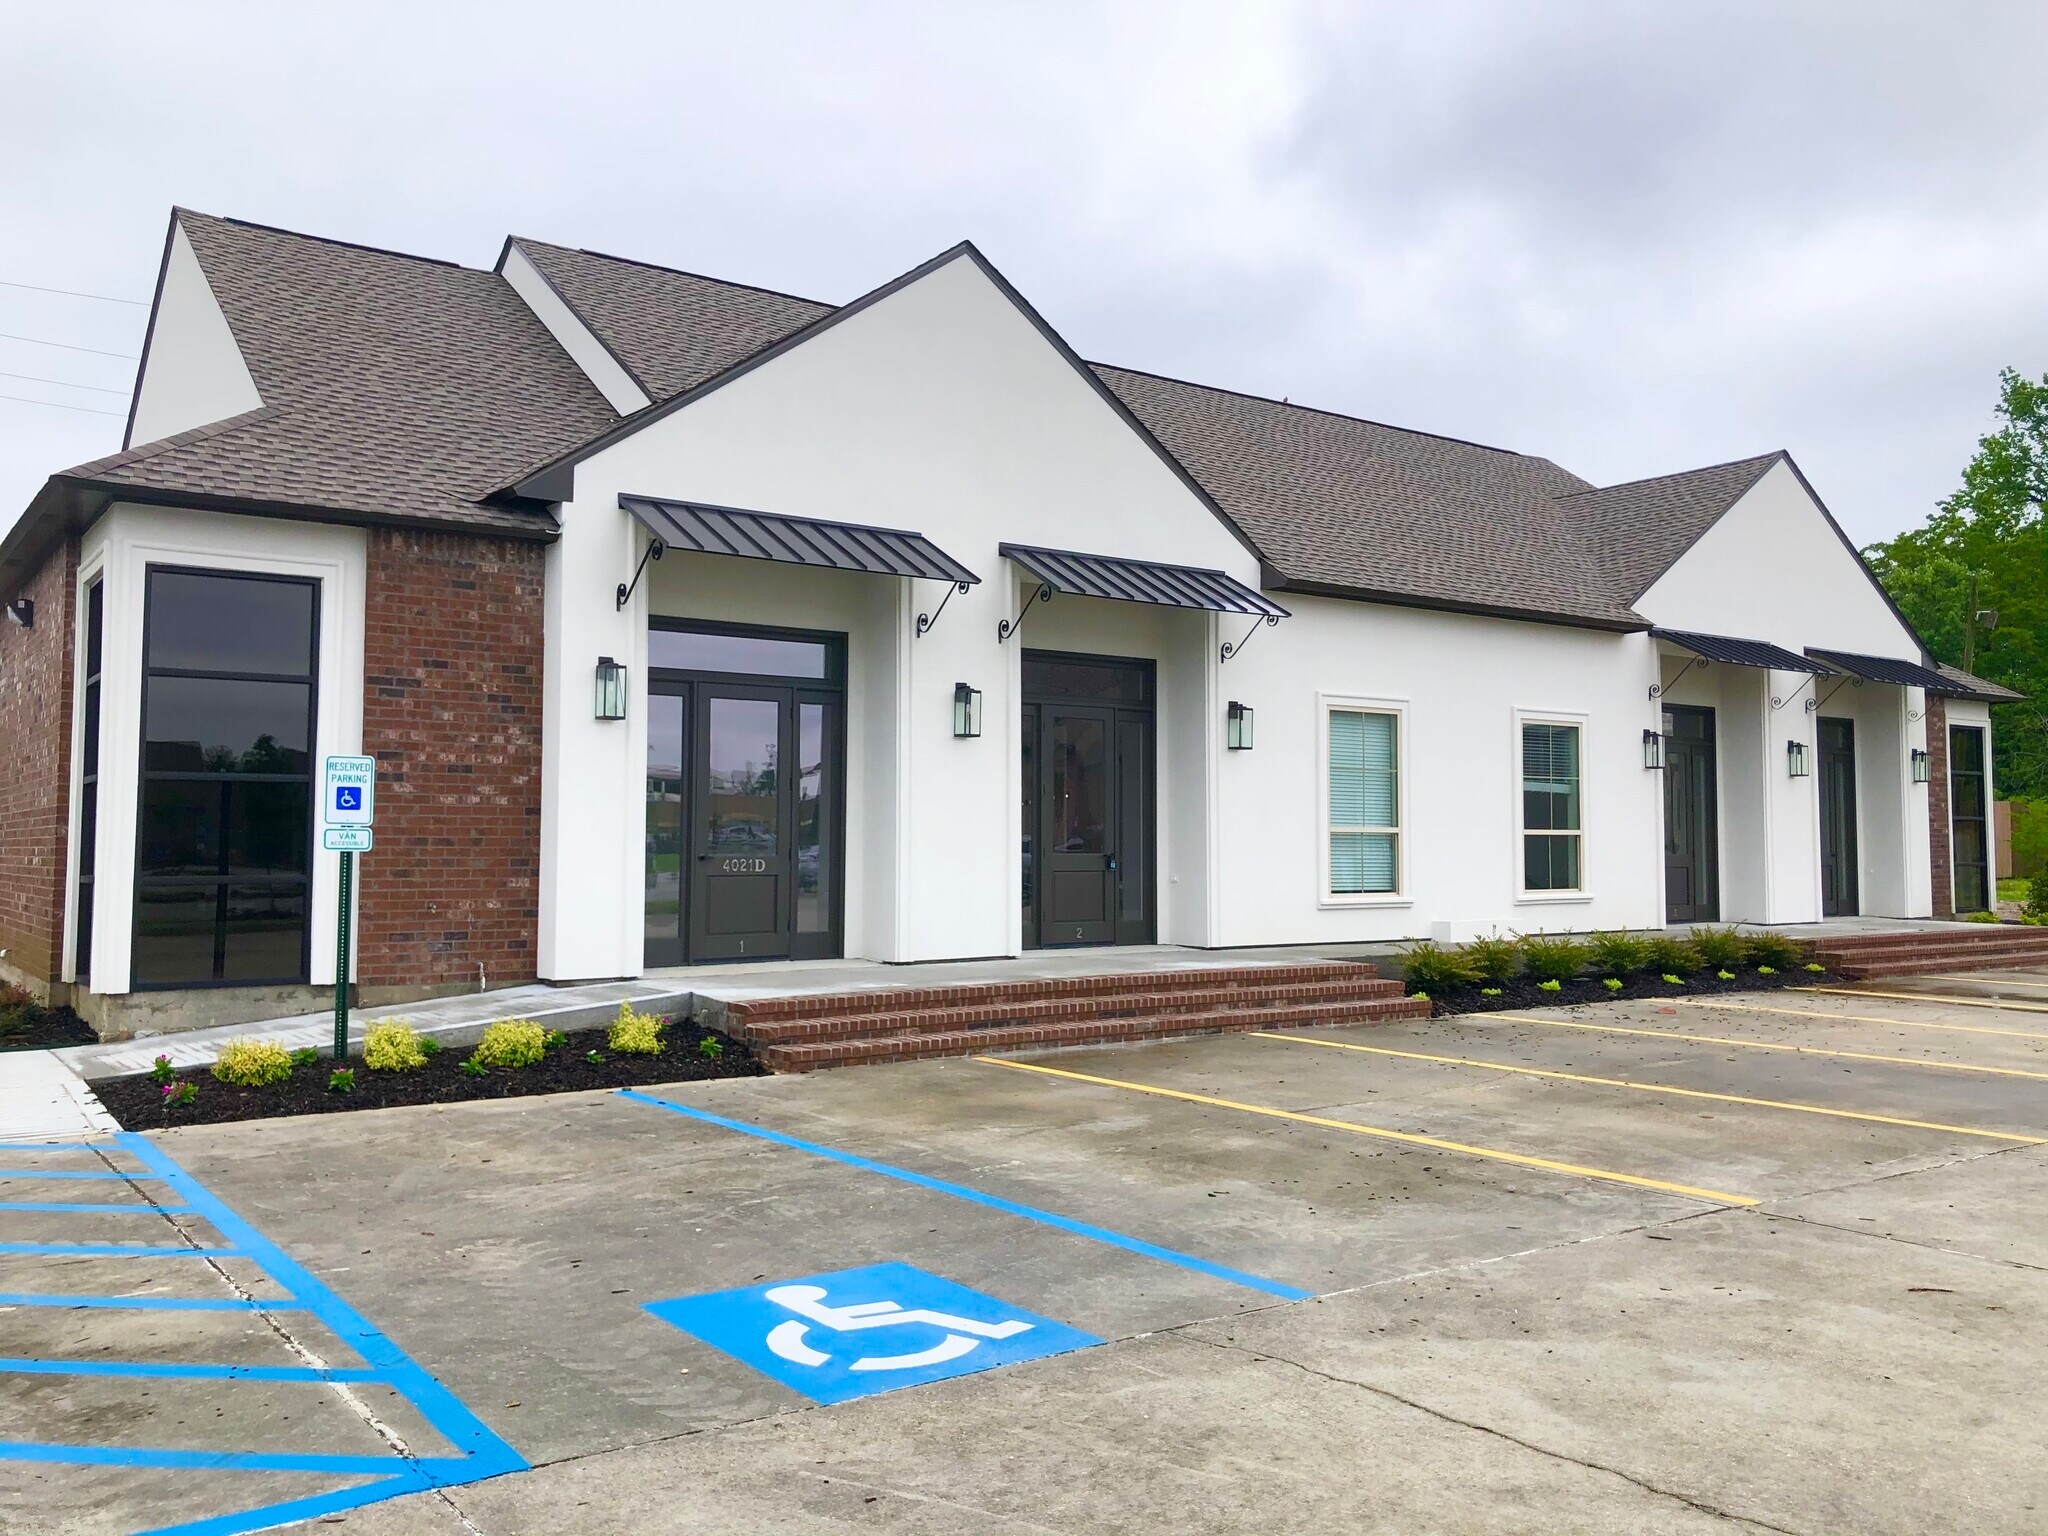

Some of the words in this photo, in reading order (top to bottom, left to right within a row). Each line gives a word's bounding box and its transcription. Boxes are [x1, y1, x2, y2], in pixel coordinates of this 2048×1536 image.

[329, 762, 371, 772] RESERVED
[331, 774, 368, 783] PARKING
[339, 832, 357, 840] VAN
[723, 859, 766, 872] 4021D
[1076, 927, 1083, 939] 2
